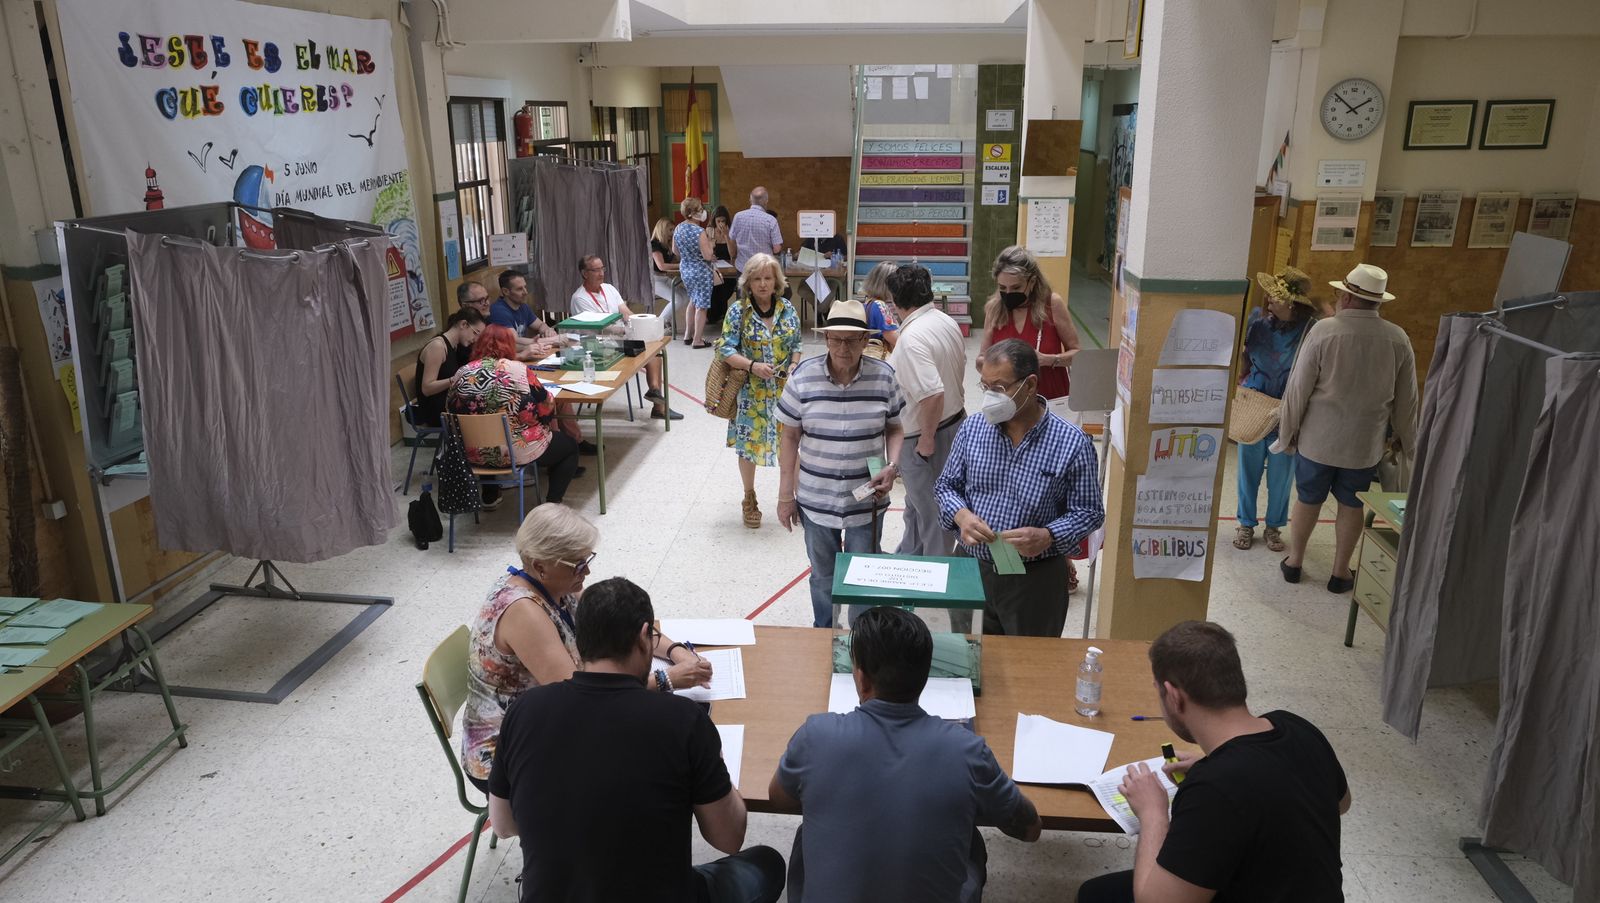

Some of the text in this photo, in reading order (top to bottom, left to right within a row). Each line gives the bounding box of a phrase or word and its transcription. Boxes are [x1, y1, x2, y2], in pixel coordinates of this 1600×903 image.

[242, 39, 282, 73] ES
[295, 39, 321, 70] EL
[326, 45, 376, 75] MAR
[155, 71, 353, 120] QUÉ QUIERES?
[868, 142, 953, 152] Y SOMOS FELICES
[284, 161, 318, 177] 5 JUNIO
[275, 189, 292, 207] DÍA
[295, 184, 334, 203] MUNDIAL
[335, 181, 356, 197] DEL
[1152, 385, 1225, 406] MATASIETE
